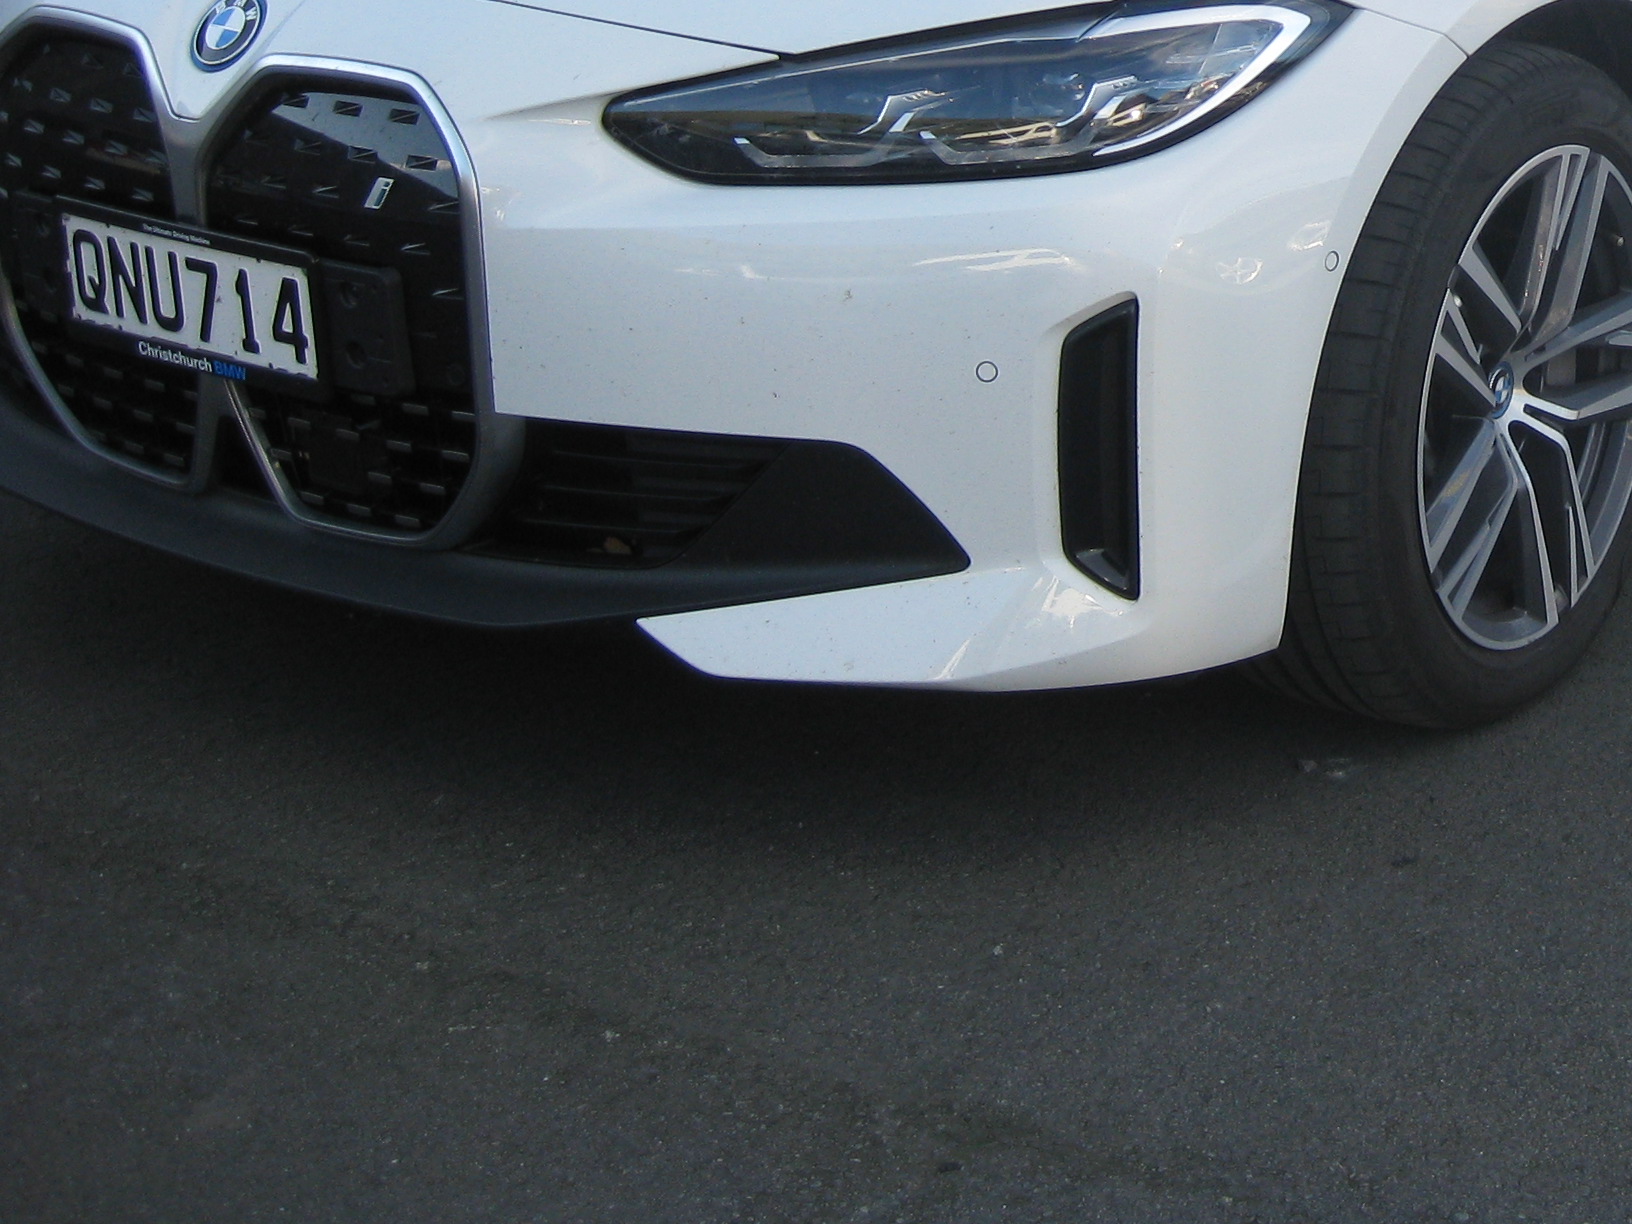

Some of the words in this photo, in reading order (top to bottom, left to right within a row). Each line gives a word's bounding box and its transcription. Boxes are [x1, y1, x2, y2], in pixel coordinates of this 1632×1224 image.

[72, 228, 311, 366] QNU714
[138, 341, 213, 373] Christchurch
[213, 360, 246, 381] BMW
